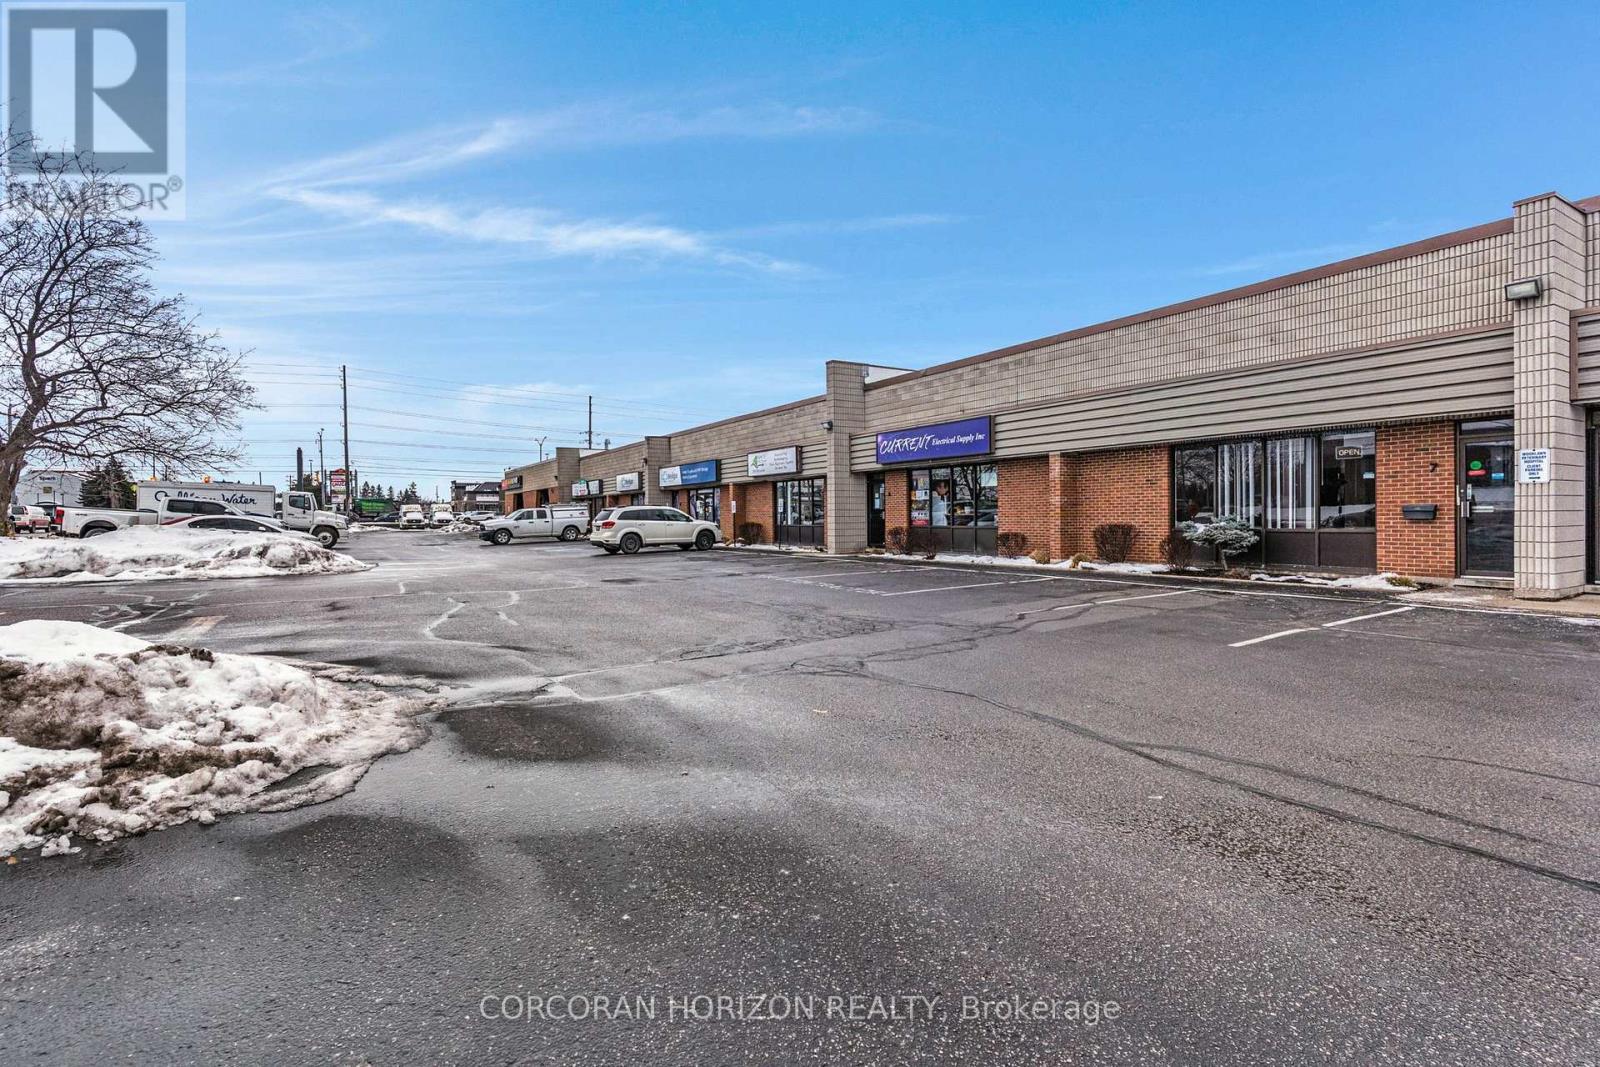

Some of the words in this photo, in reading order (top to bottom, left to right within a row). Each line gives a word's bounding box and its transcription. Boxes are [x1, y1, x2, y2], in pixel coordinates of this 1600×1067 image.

[880, 433, 935, 455] CURRENT
[932, 436, 956, 446] Electrical
[956, 433, 975, 445] Supply
[975, 433, 986, 441] Inc
[1338, 448, 1360, 456] OPEN
[221, 493, 257, 505] Water
